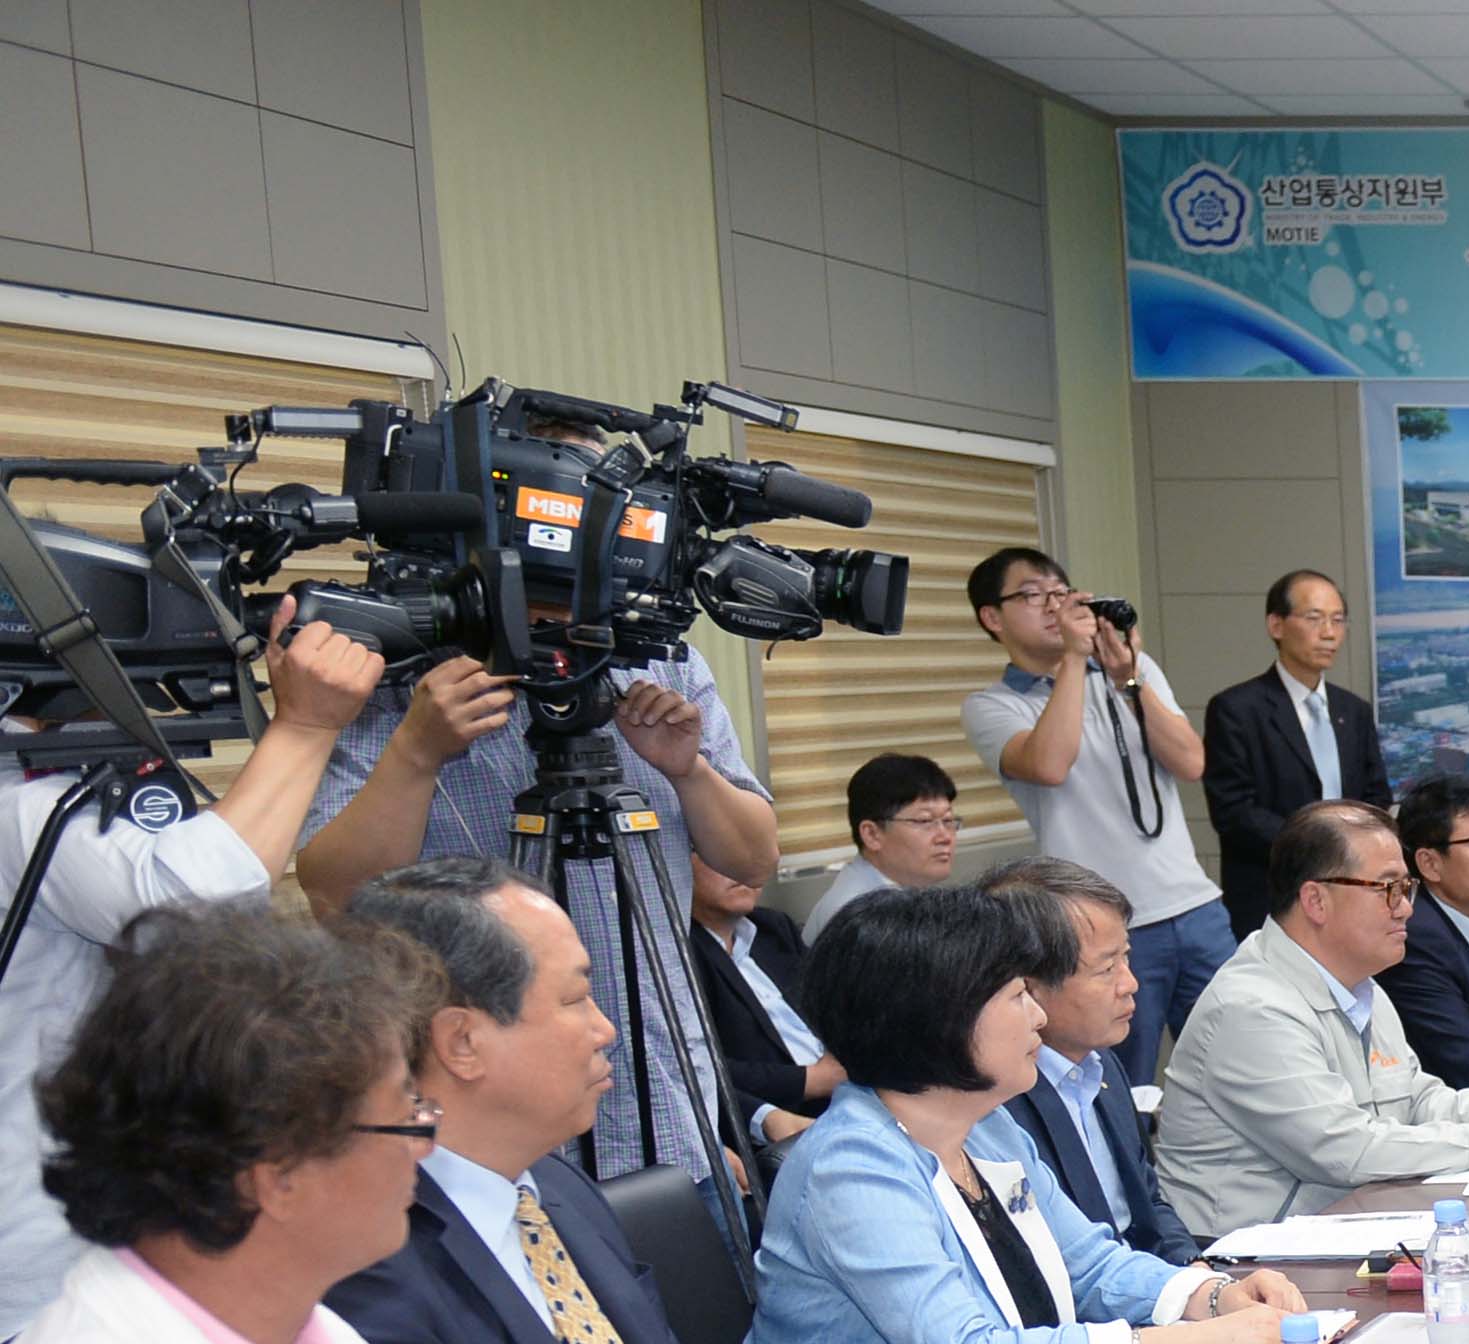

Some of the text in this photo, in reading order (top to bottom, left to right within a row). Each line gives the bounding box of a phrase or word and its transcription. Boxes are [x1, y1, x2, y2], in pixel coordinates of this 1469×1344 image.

[1261, 177, 1445, 208] 산업통상자원부
[1266, 227, 1319, 242] MOTIE
[527, 495, 583, 521] MBN
